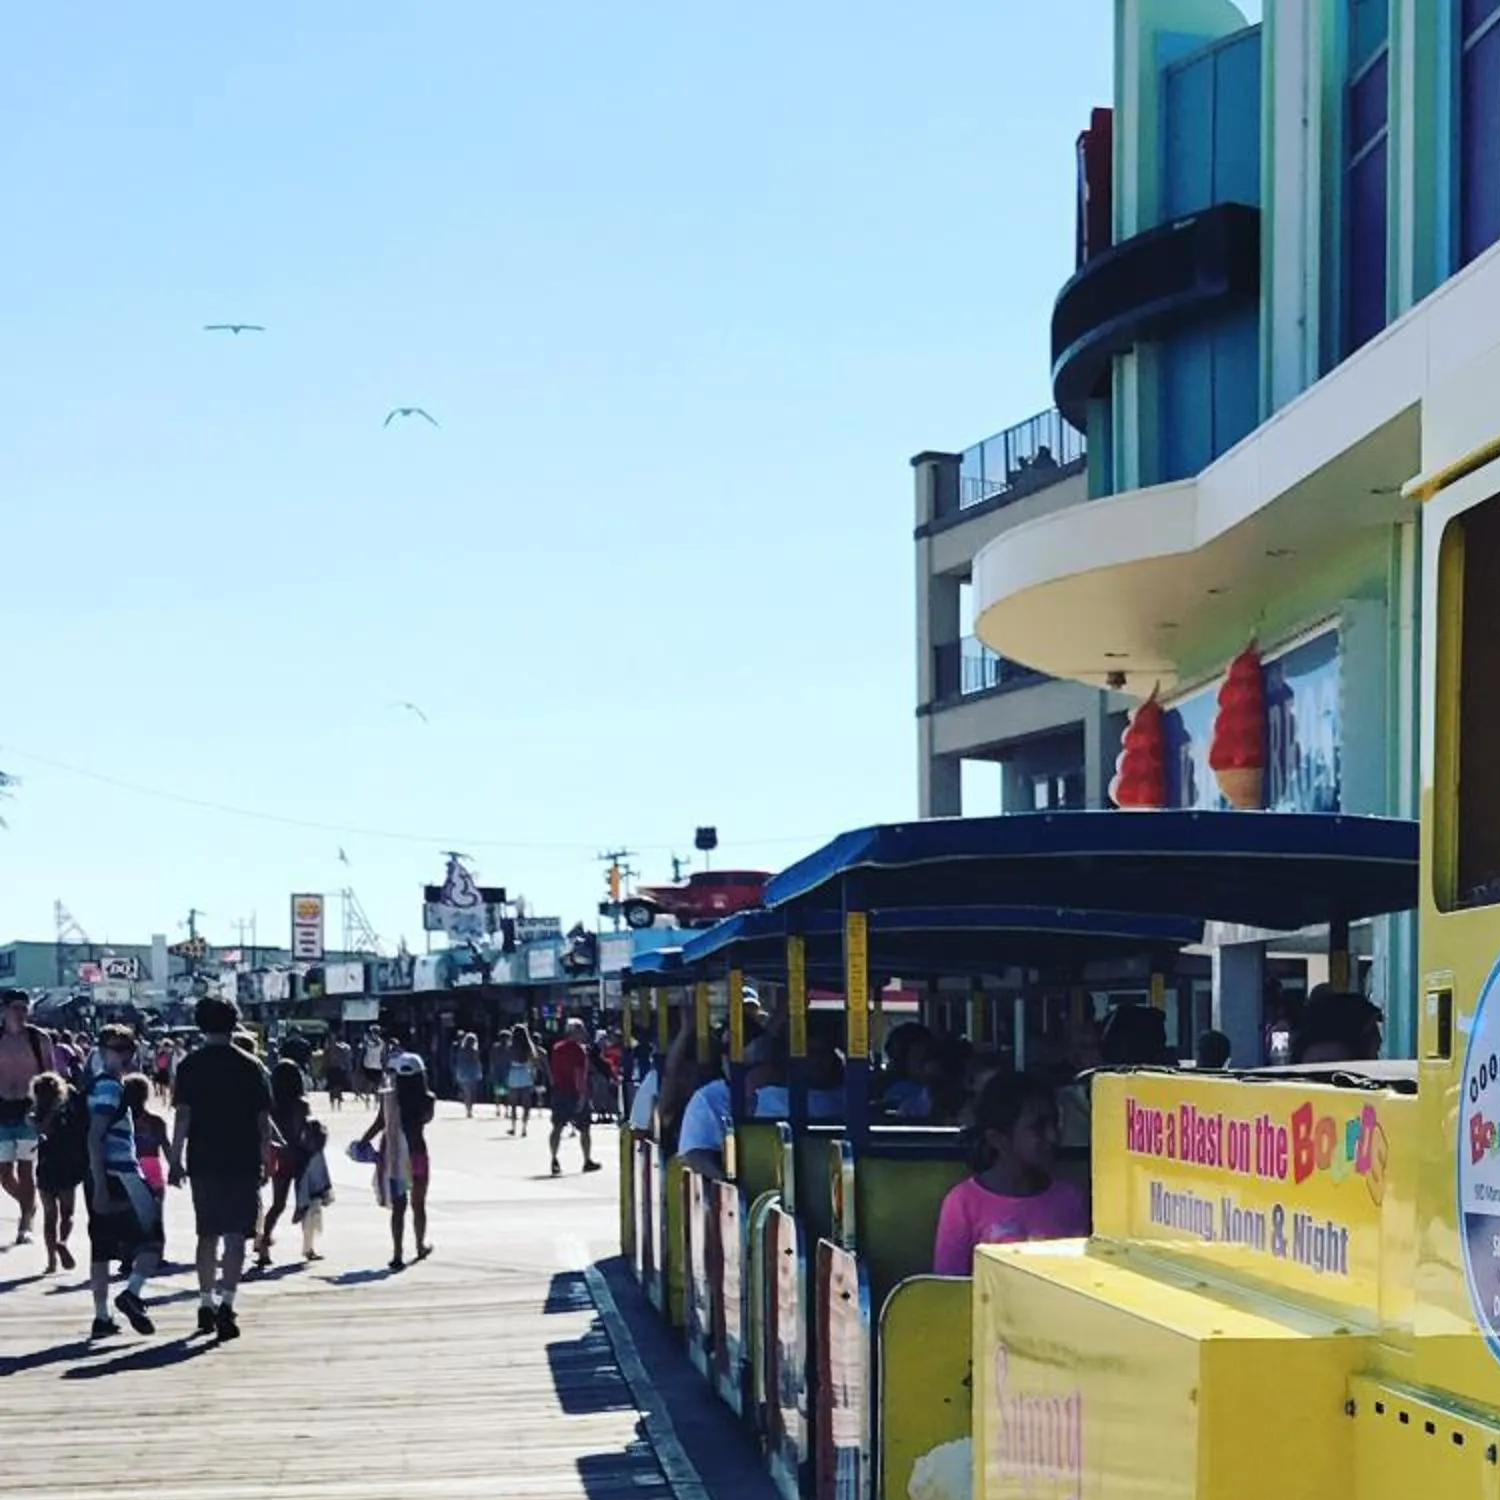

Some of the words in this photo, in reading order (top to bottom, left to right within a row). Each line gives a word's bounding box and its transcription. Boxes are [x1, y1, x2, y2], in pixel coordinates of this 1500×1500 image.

[1125, 1098, 1163, 1157] Have
[1166, 1111, 1176, 1159] a
[1180, 1103, 1223, 1168] Blast
[1228, 1119, 1250, 1173] on
[1255, 1114, 1288, 1180] the
[1221, 1197, 1265, 1251] Noon
[1272, 1203, 1288, 1258] &
[1293, 1212, 1349, 1275] Night
